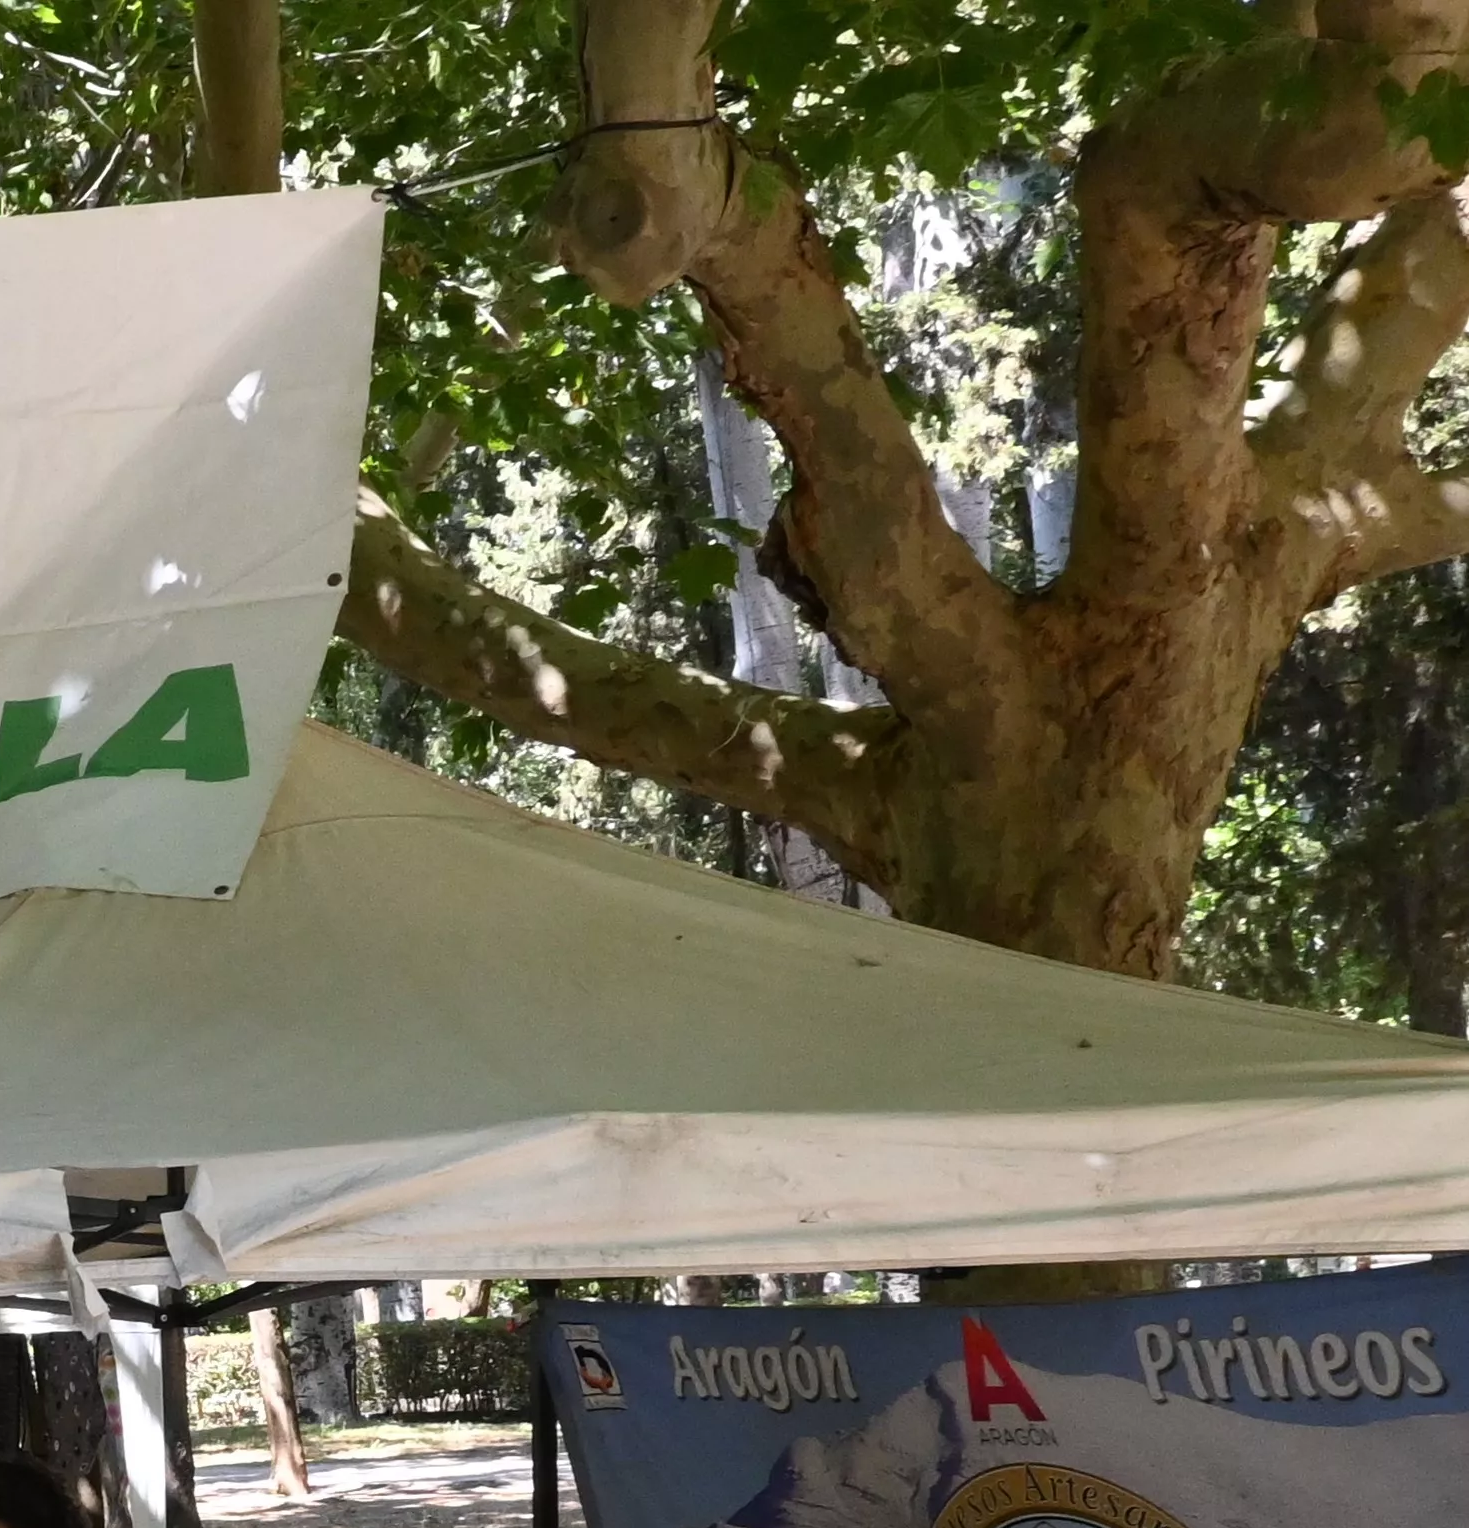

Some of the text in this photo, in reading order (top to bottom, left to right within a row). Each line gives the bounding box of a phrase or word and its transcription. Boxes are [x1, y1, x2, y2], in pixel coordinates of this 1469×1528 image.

[668, 1326, 860, 1413] Aragón
[962, 1314, 1048, 1422] A
[1134, 1315, 1449, 1404] Pirineos
[978, 1423, 1059, 1448] ARAGÓN
